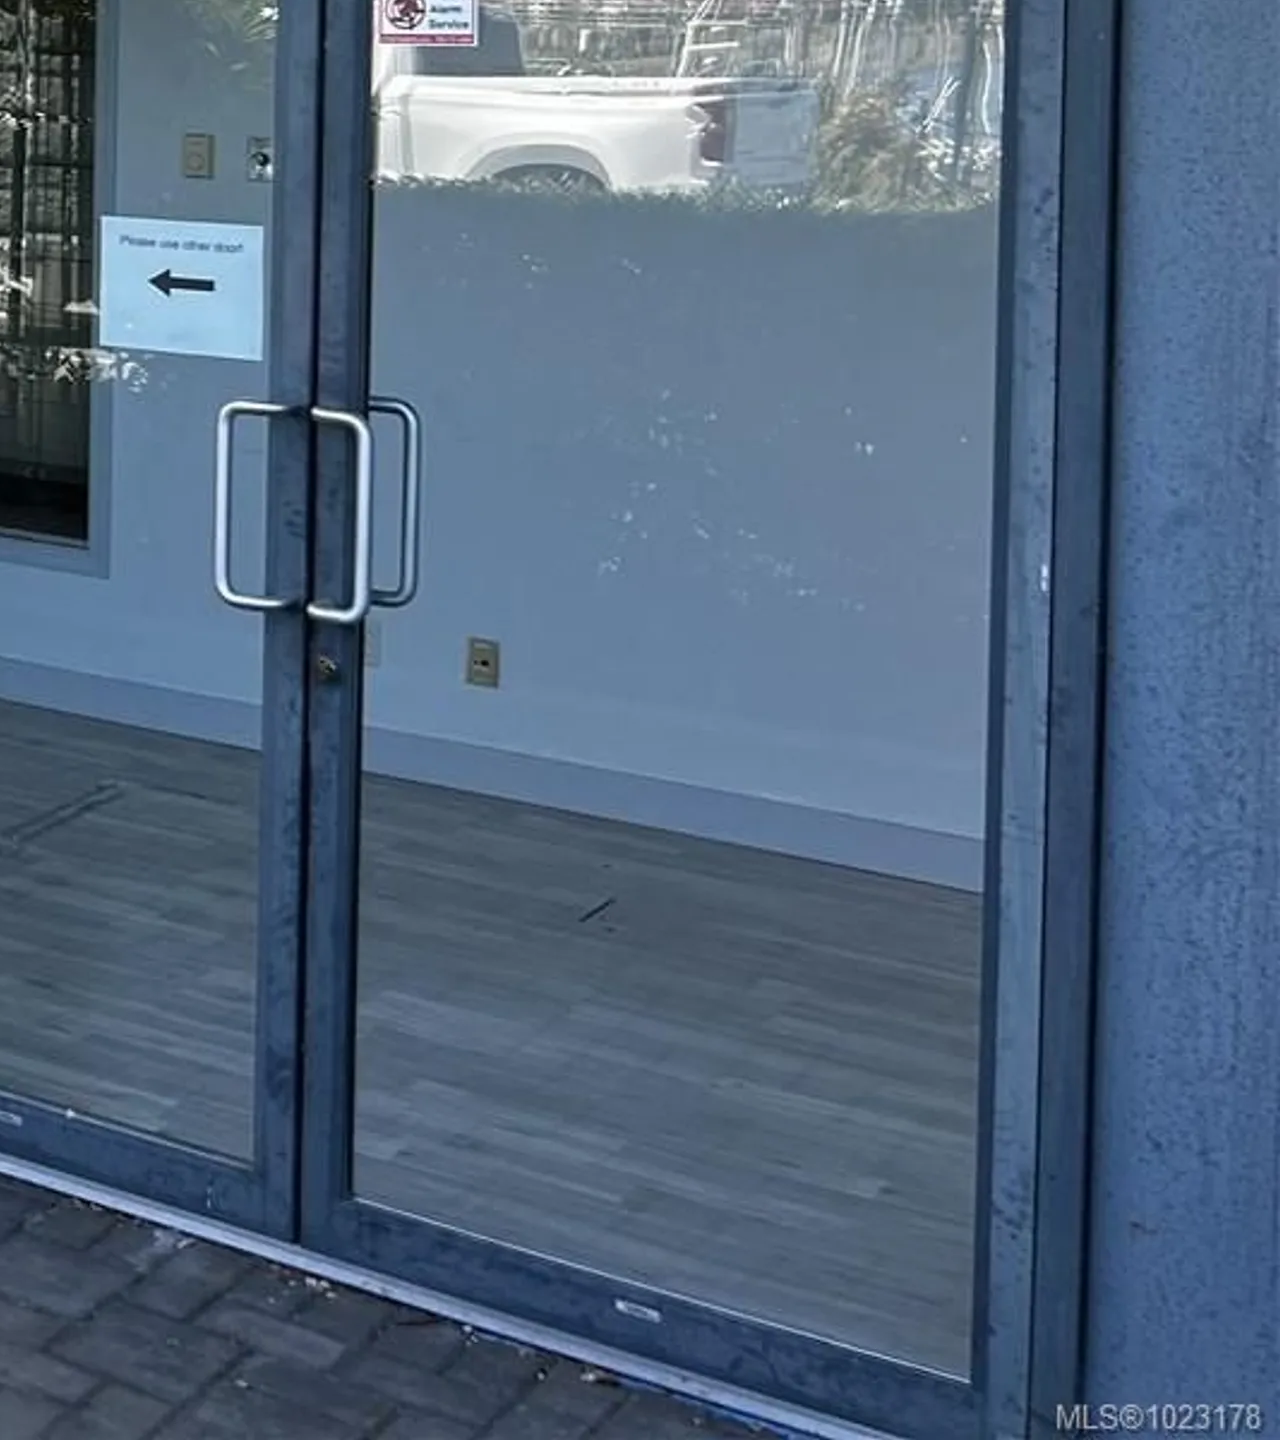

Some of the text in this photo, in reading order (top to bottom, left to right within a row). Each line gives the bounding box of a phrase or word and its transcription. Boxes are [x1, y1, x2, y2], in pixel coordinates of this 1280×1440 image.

[119, 234, 156, 248] Please
[159, 239, 179, 250] use
[182, 239, 210, 251] other
